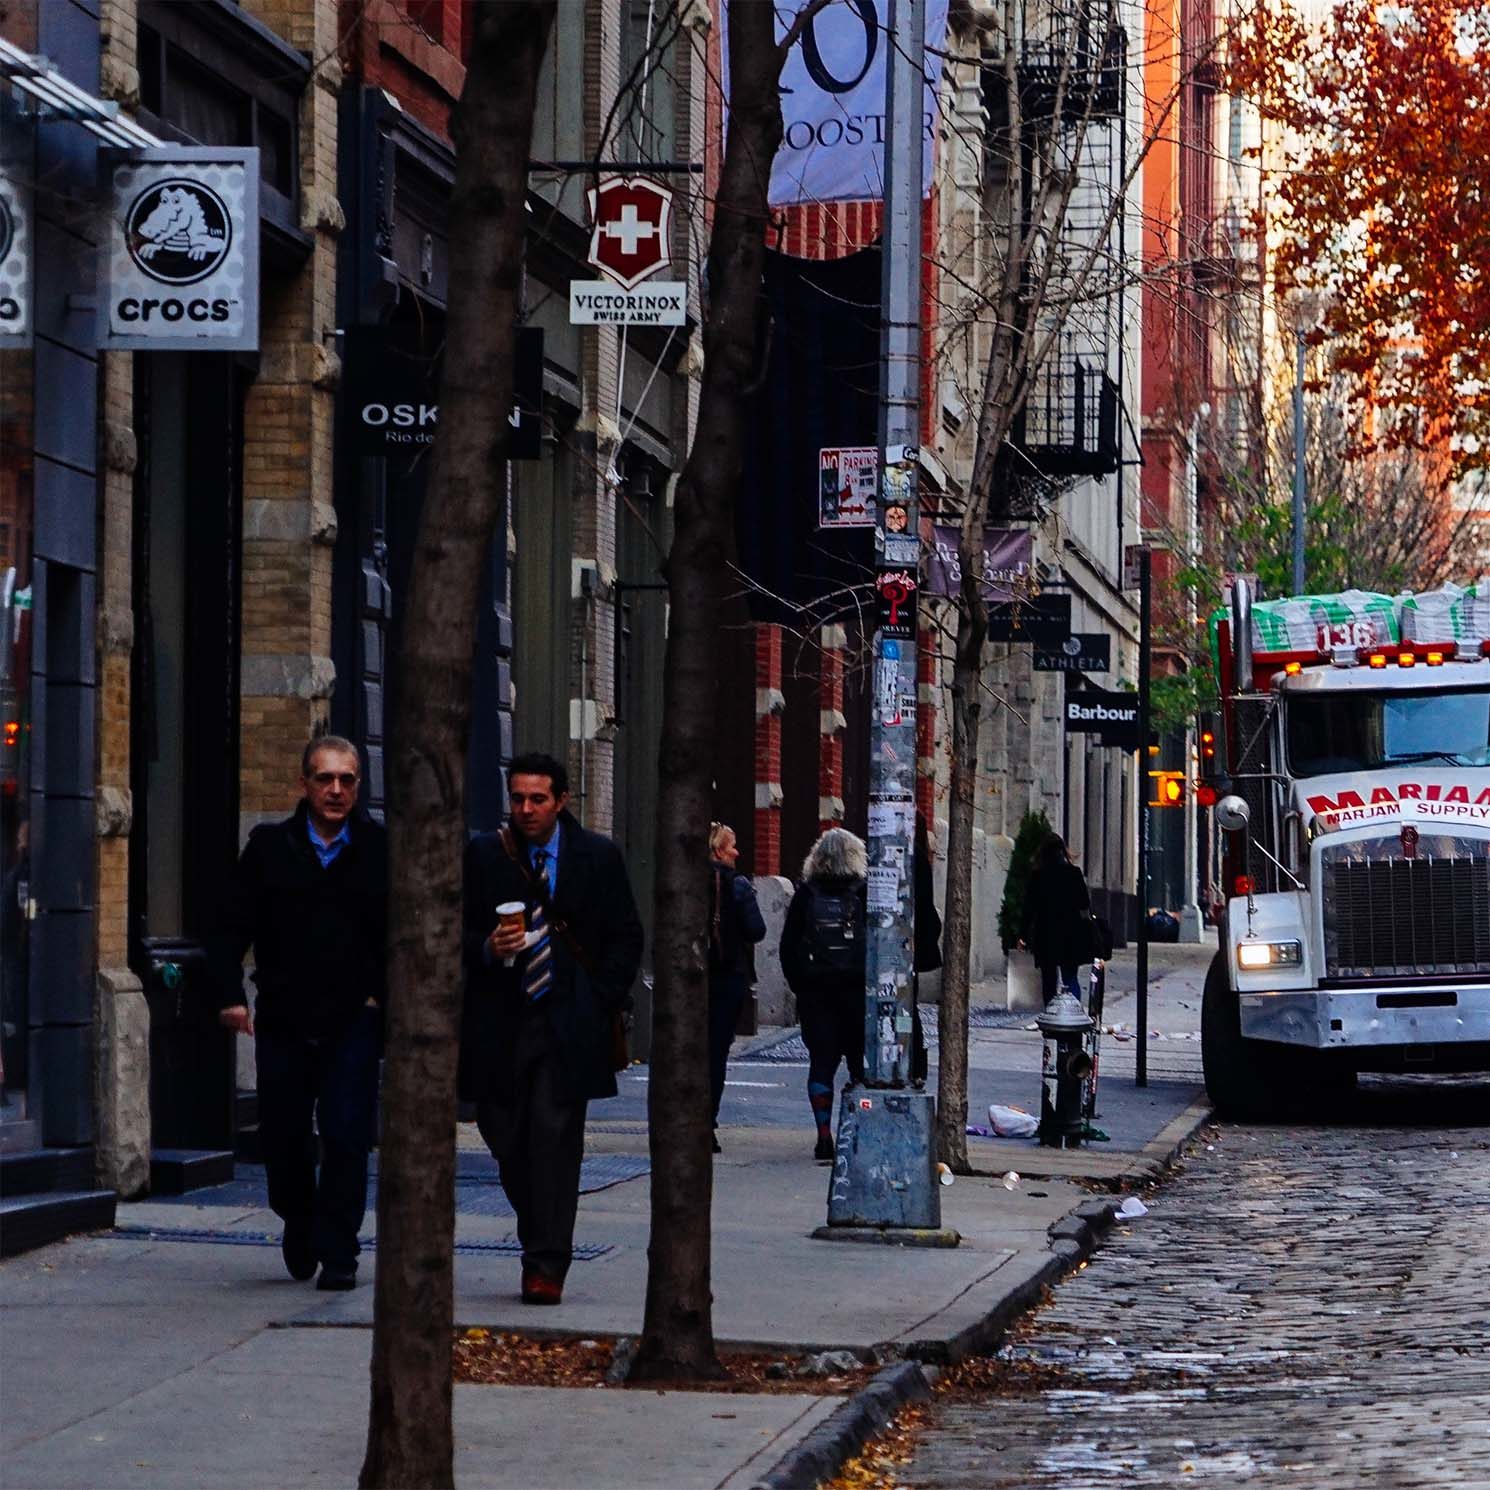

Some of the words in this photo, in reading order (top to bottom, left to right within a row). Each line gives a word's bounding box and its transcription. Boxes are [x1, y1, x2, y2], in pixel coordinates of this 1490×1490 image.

[786, 112, 935, 150] OOSTR
[575, 295, 680, 310] VICTORINOX
[593, 311, 625, 321] SWISS
[629, 312, 661, 322] ARMY
[362, 403, 521, 428] OSKN
[385, 431, 412, 443] Rio
[415, 431, 434, 444] de
[822, 455, 839, 470] NO
[1038, 657, 1106, 669] ATHLETA
[1068, 703, 1137, 721] Barbour
[1327, 804, 1401, 825] MARJAM
[1416, 802, 1490, 819] SUPPLY
